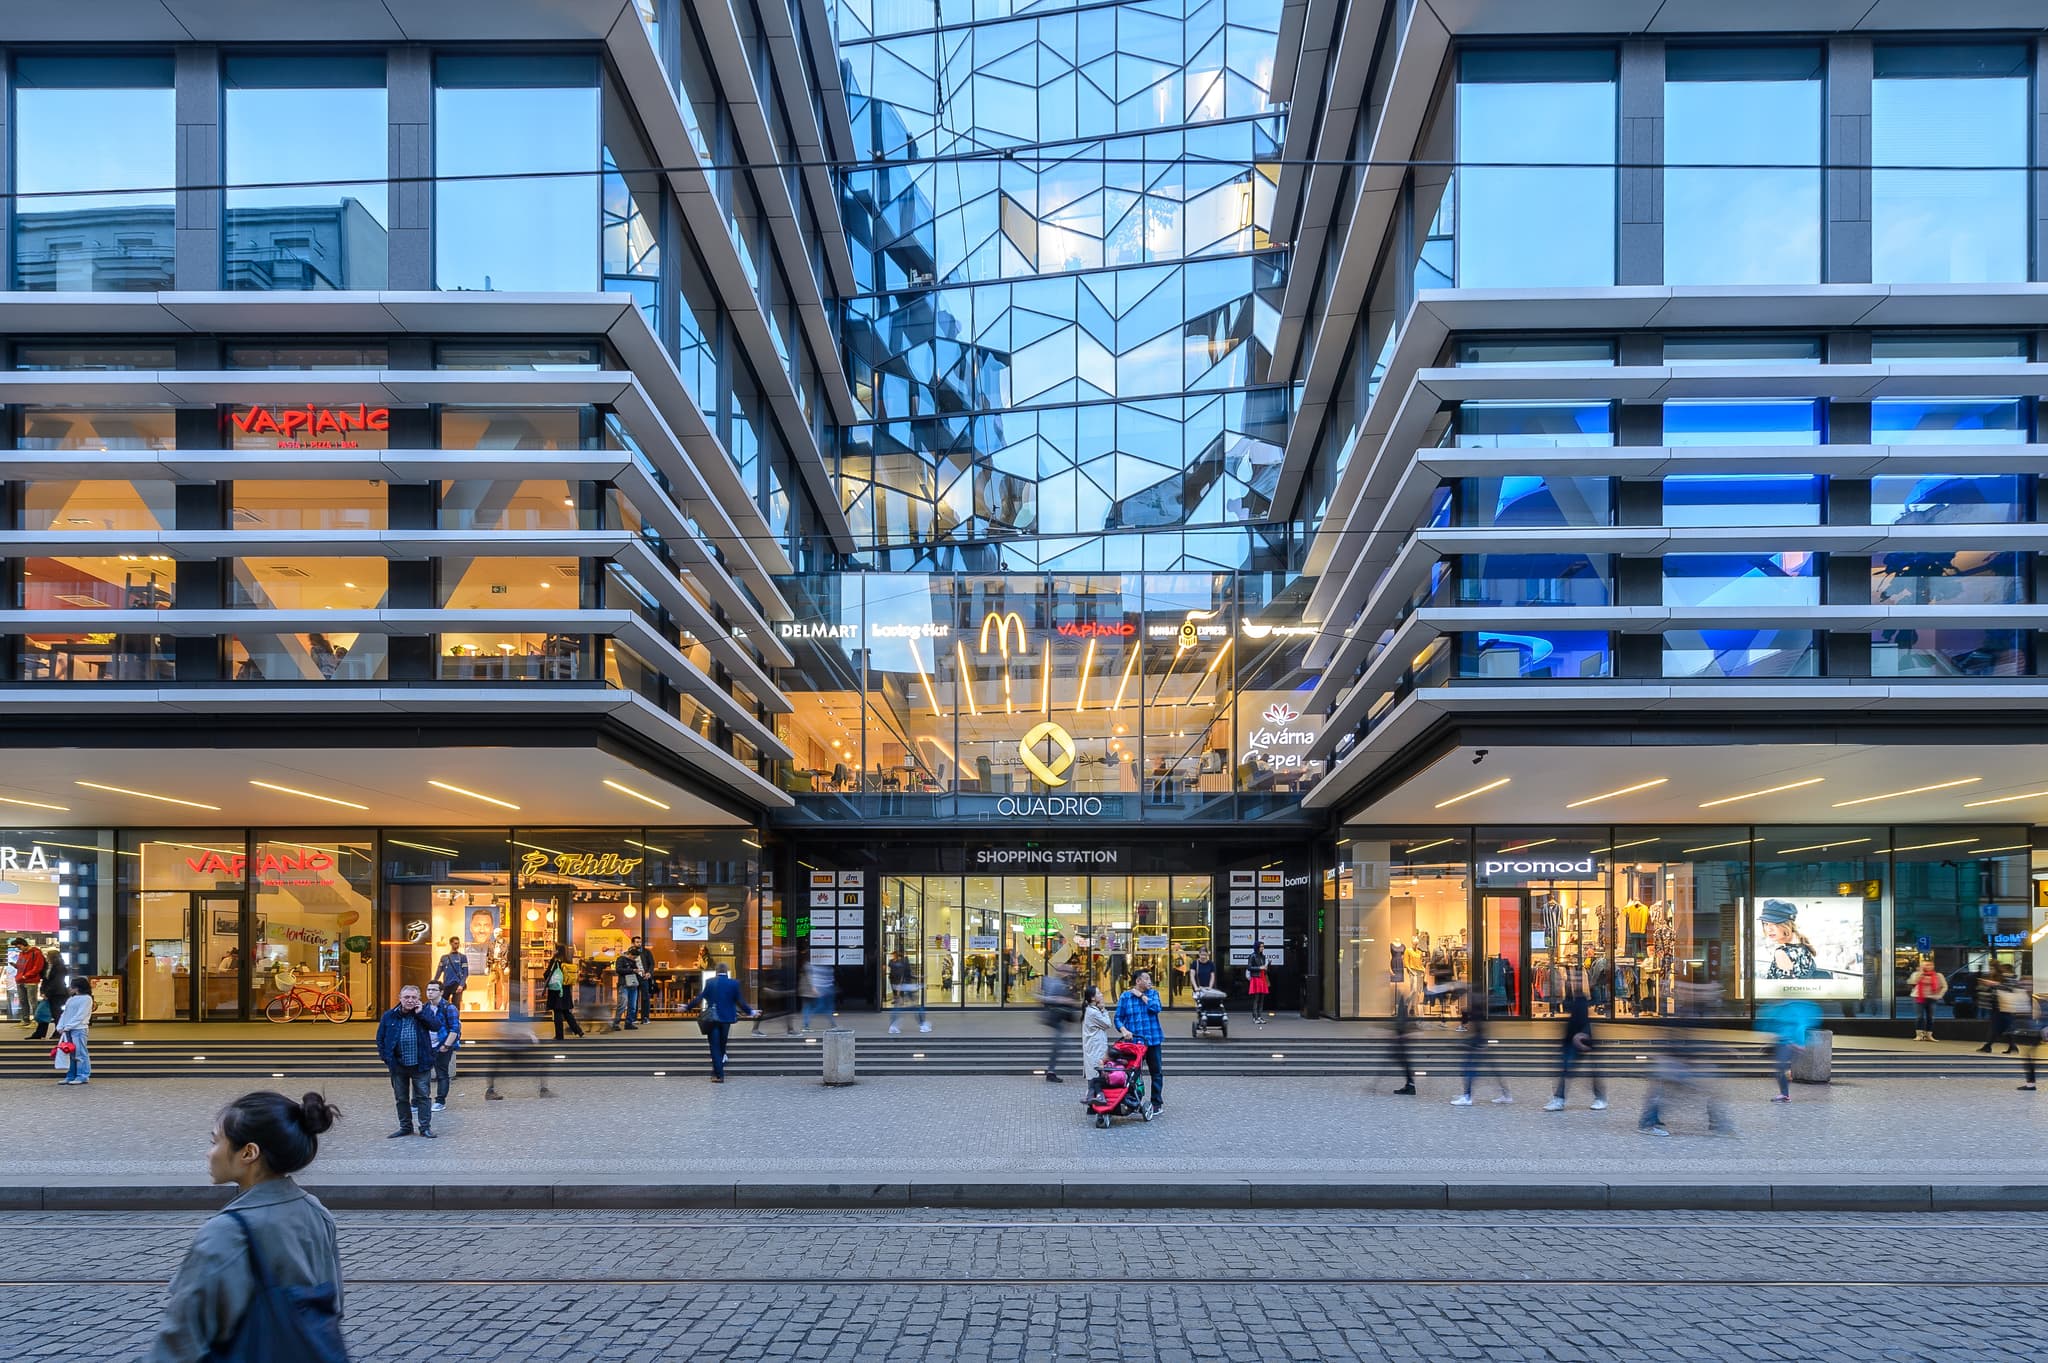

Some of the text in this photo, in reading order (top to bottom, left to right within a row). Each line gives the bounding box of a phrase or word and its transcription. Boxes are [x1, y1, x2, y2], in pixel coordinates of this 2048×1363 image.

[781, 622, 858, 638] DELMART
[1249, 727, 1314, 749] Kavárna
[997, 797, 1102, 816] QUADRIO
[554, 853, 643, 876] Tchibo
[977, 850, 1117, 863] SHOPPING STATION
[1485, 858, 1592, 876] promod
